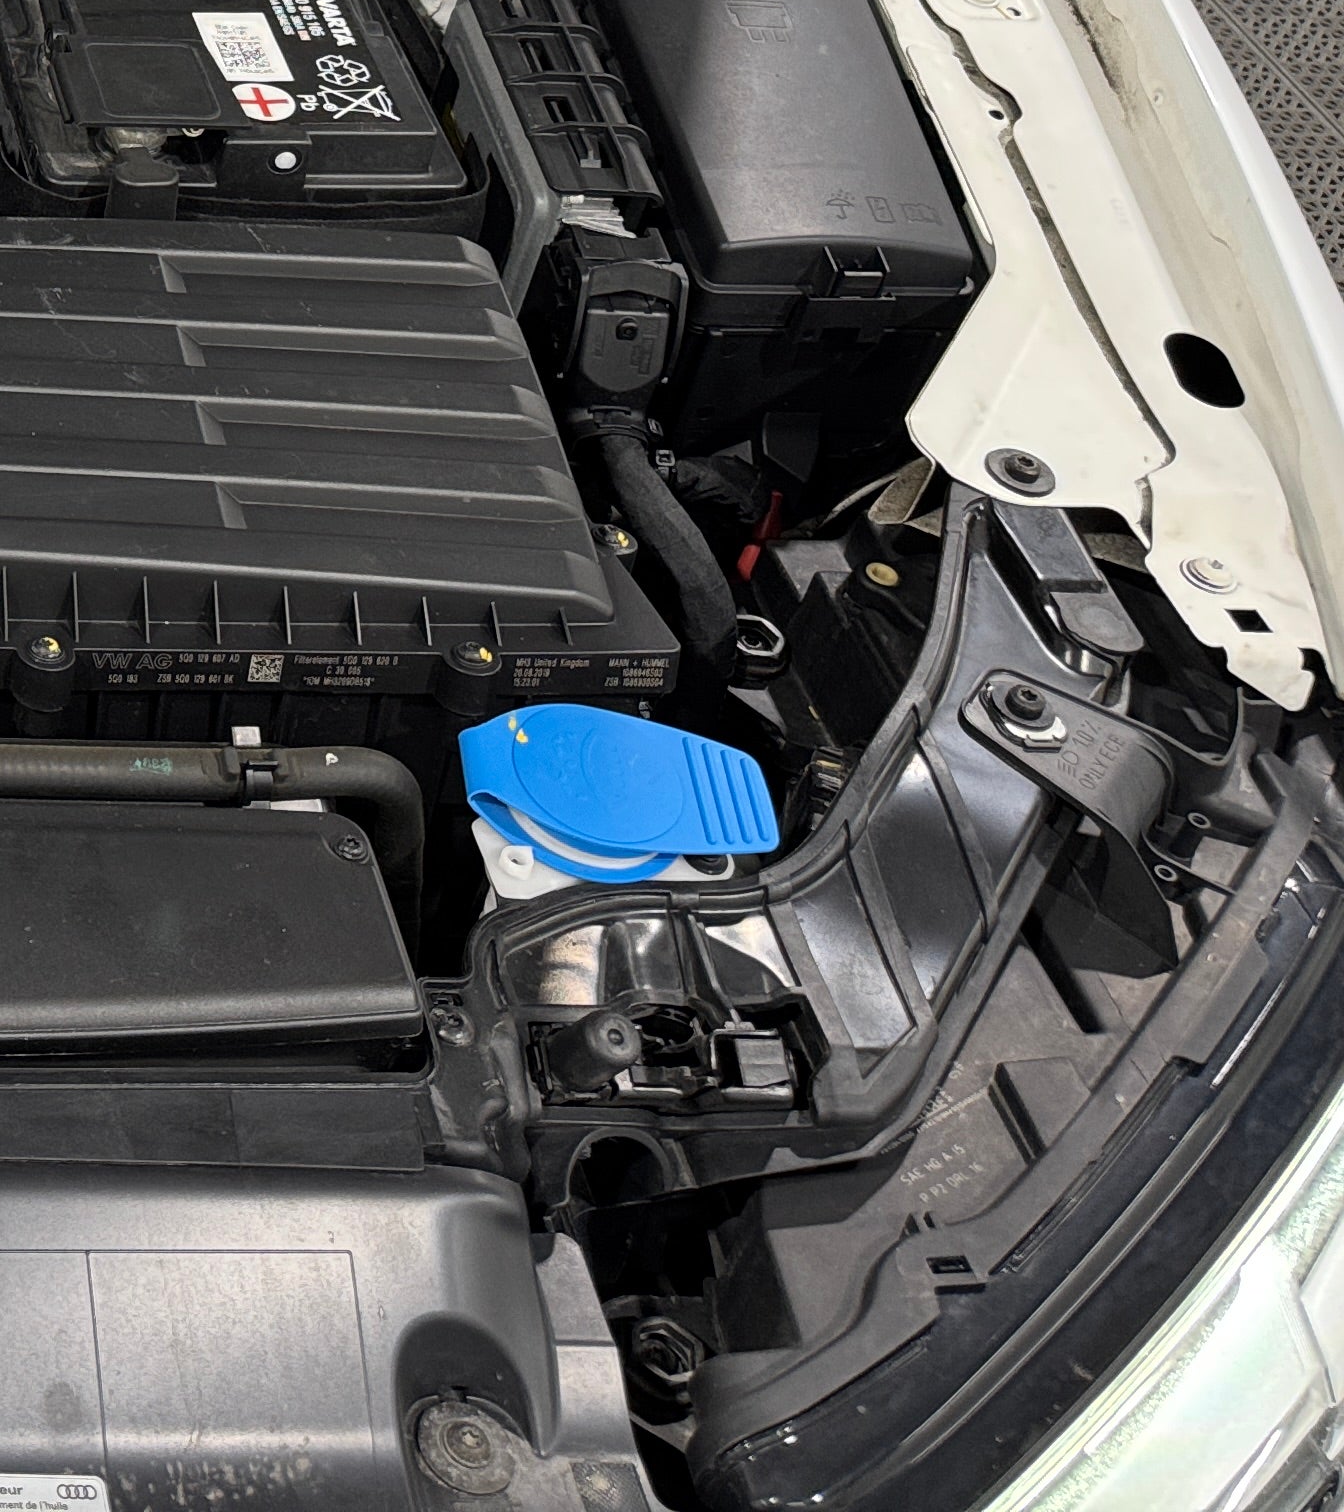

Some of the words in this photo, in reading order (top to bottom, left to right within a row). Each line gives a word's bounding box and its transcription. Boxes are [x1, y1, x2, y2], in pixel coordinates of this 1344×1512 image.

[297, 94, 317, 111] Pb
[92, 653, 133, 669] VW
[136, 653, 172, 669] AG
[1079, 758, 1108, 789] ONLY
[1099, 734, 1125, 761] ECE
[900, 1167, 925, 1186] SAE
[924, 1157, 943, 1171] HG
[945, 1172, 970, 1188] DRL
